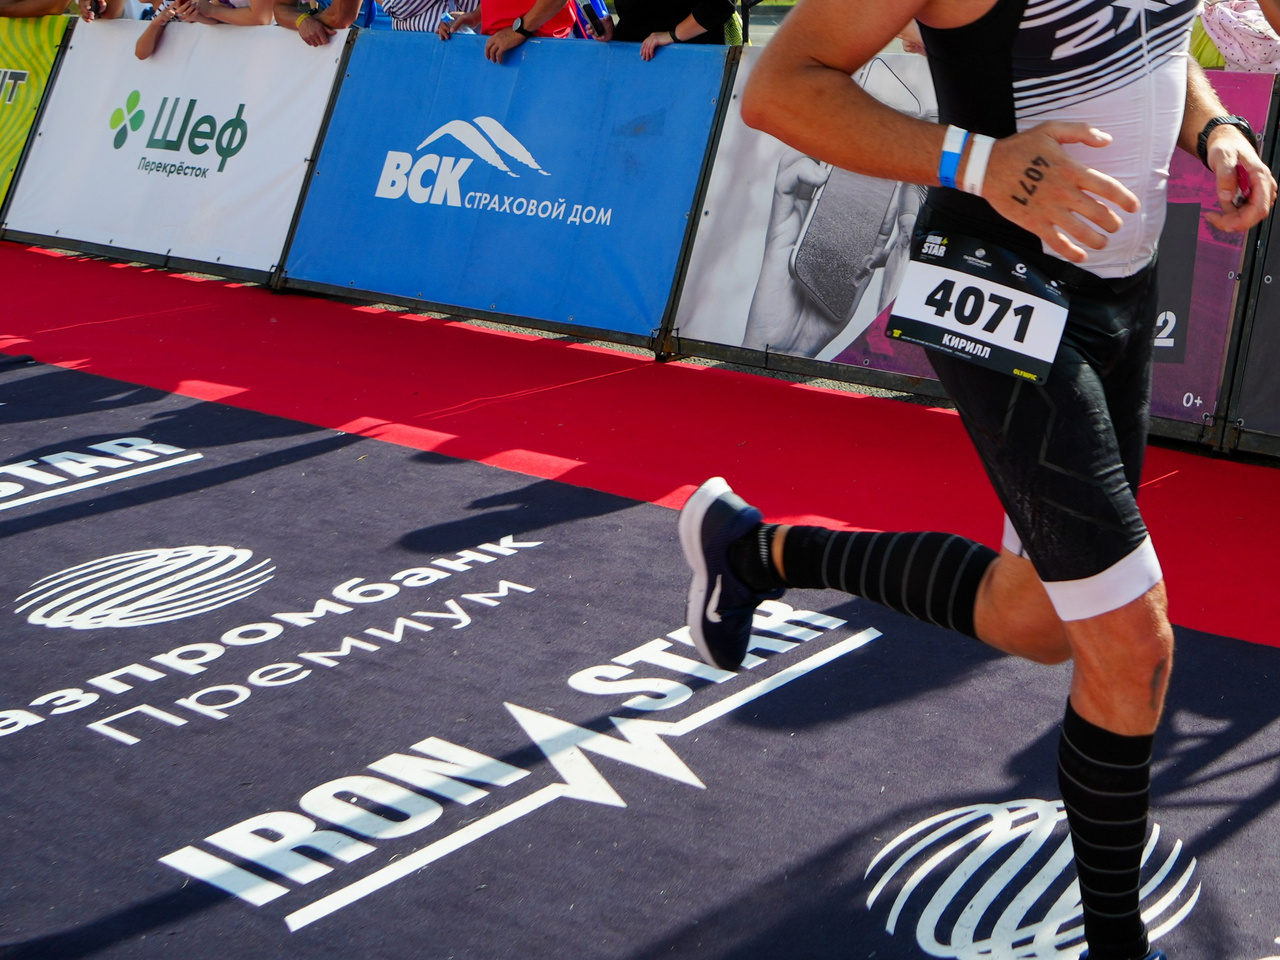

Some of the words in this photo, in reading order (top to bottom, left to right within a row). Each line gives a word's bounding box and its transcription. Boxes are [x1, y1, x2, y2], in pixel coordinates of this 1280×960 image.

[146, 97, 248, 173] Шеф
[138, 157, 210, 179] Перекрёсток
[374, 150, 474, 208] ВСК
[464, 191, 567, 220] СТРАХОВОЙ
[567, 204, 613, 226] ДОМ
[921, 242, 947, 258] STAR
[925, 278, 1035, 344] 4071
[942, 333, 991, 359] КИРИЛЛ
[1013, 368, 1038, 381] OLYMPIC
[1182, 392, 1203, 408] 0+
[86, 579, 536, 746] Премиум
[157, 736, 532, 907] IRON
